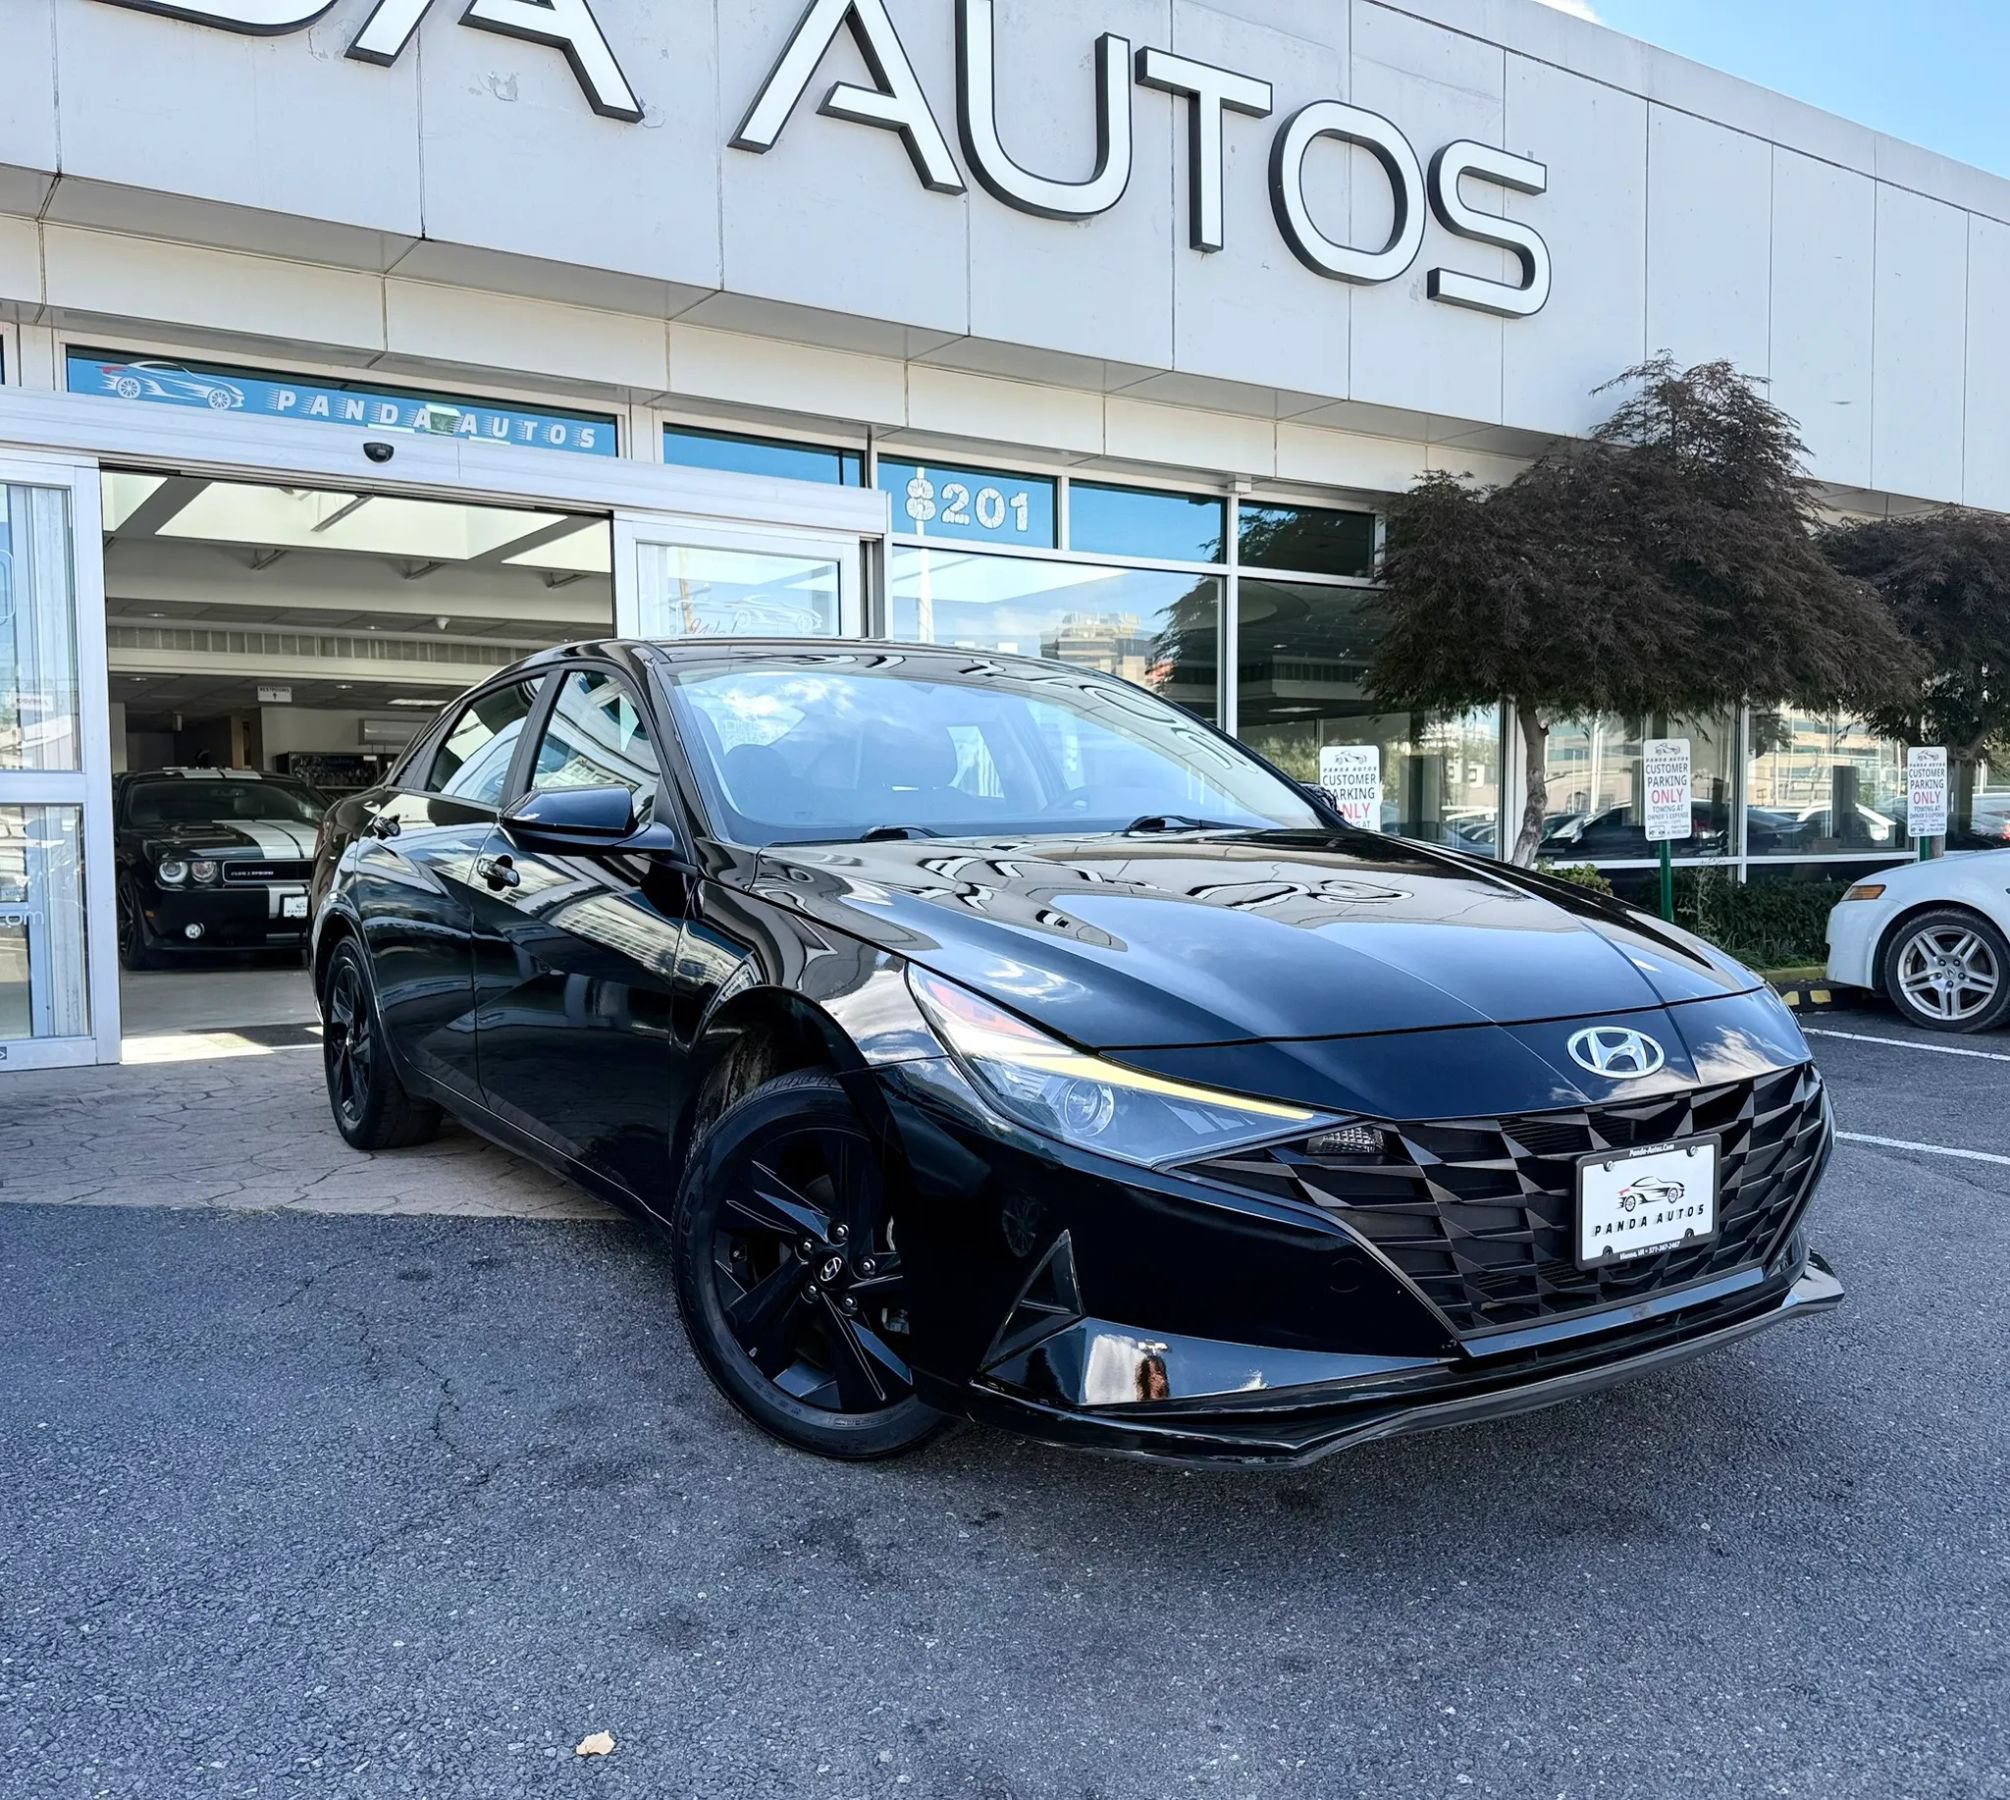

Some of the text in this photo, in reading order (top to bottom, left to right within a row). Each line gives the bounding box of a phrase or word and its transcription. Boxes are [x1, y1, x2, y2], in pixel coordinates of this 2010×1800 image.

[726, 0, 1552, 319] AUTOS
[269, 391, 596, 449] PANDA AUTOS
[906, 477, 1028, 532] 8201
[1645, 763, 1688, 775] CUSTOMER
[1909, 768, 1945, 778] CUSTOMER
[1322, 774, 1377, 786] CUSTOMER
[1647, 775, 1687, 787] PARKING
[1910, 779, 1944, 790] PARKING
[1333, 787, 1375, 801] ARKING
[1651, 788, 1684, 804] ONLY
[1913, 791, 1941, 805] ONLY
[1341, 802, 1371, 819] NLY
[1592, 1204, 1705, 1237] PANDA AUTOS
